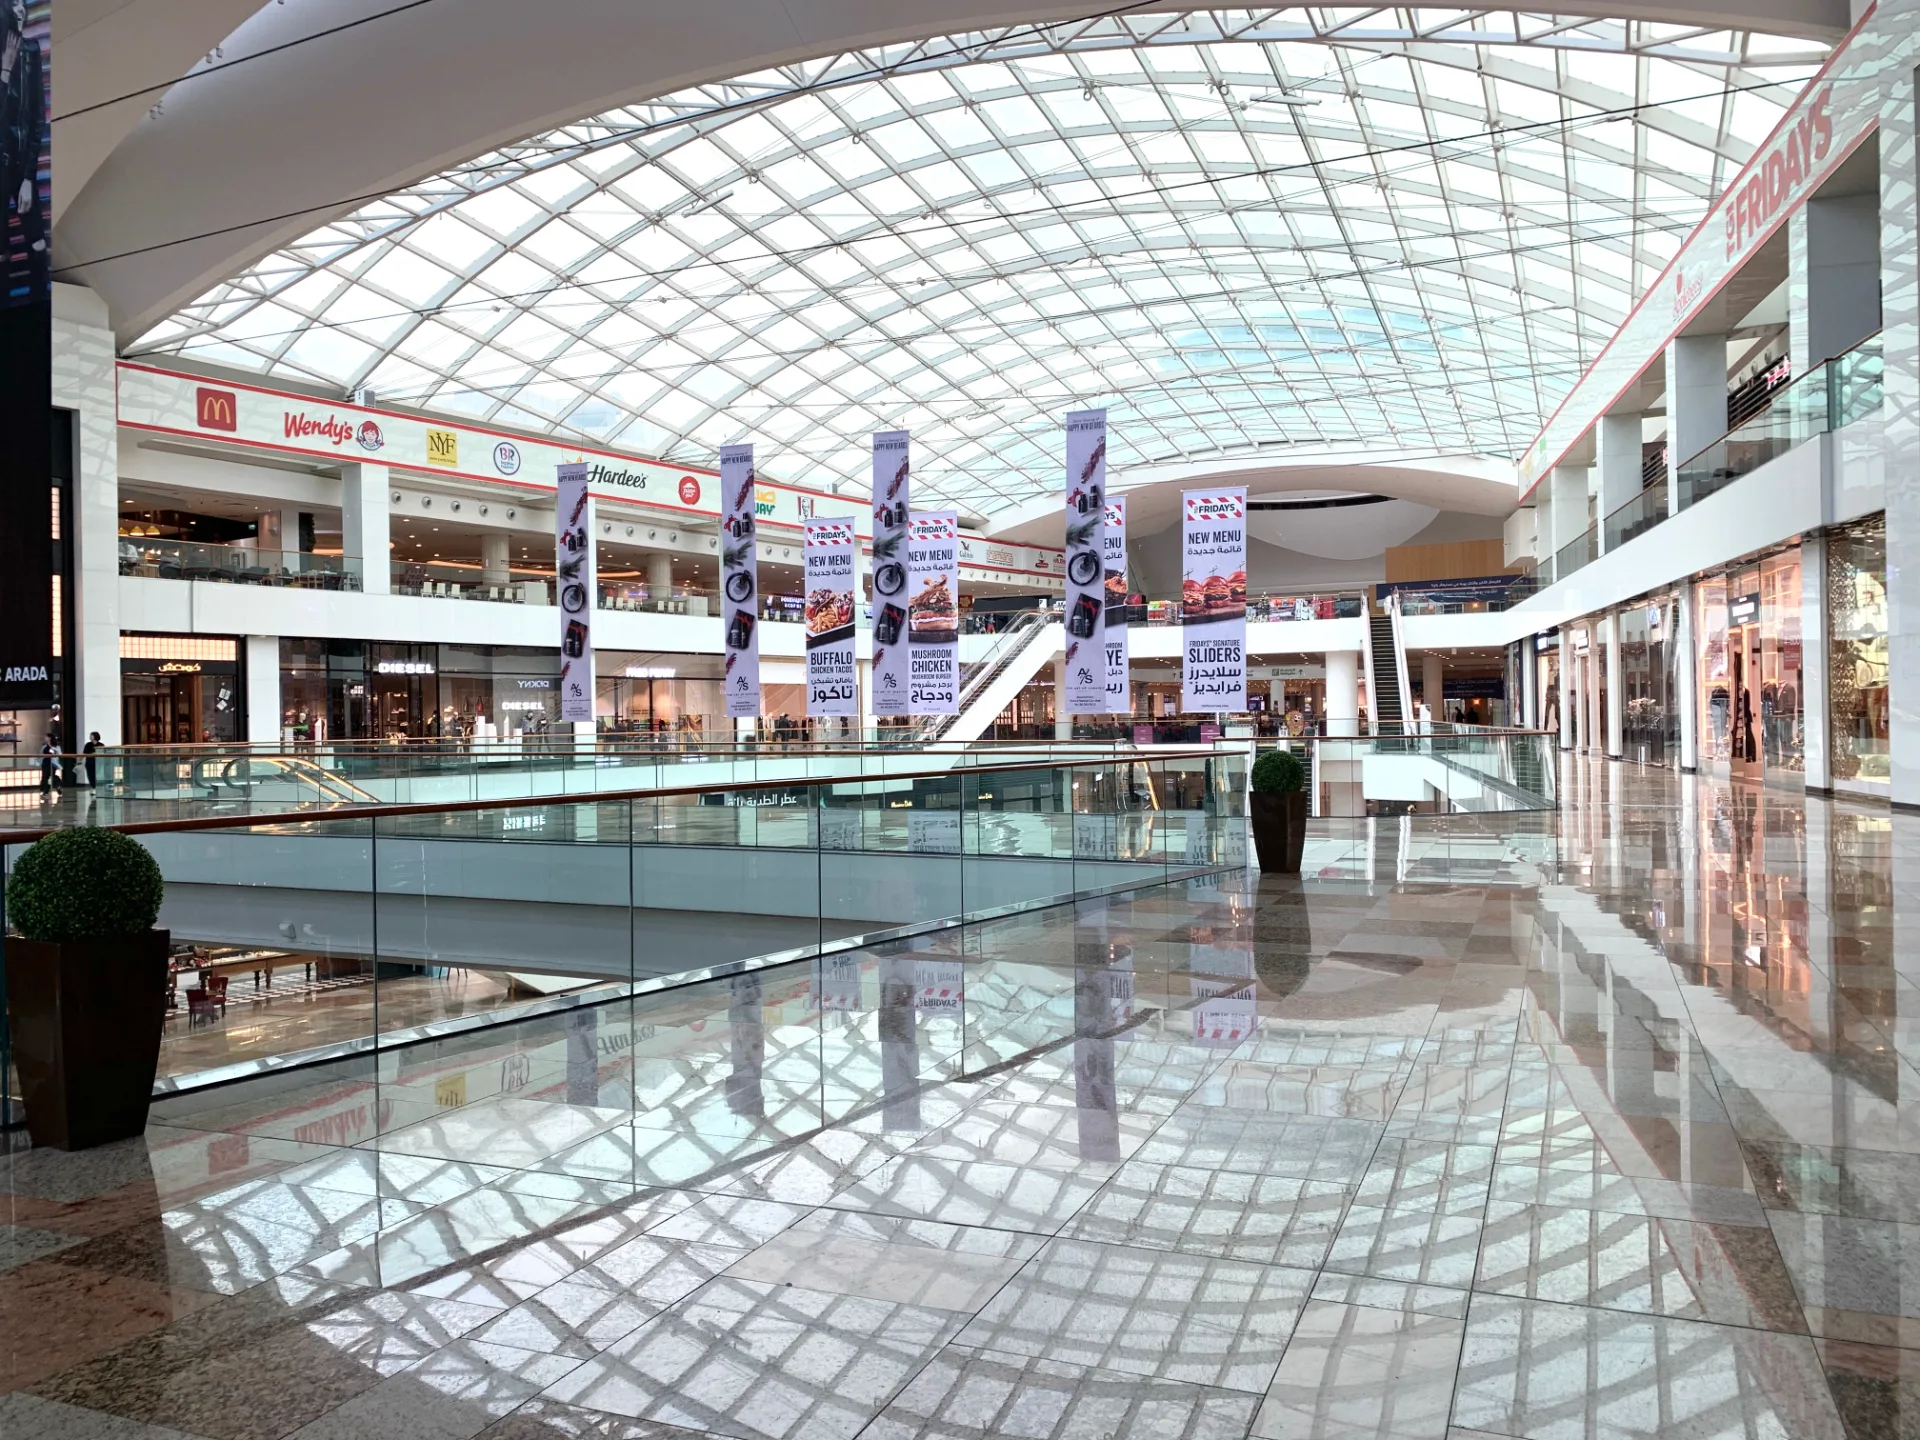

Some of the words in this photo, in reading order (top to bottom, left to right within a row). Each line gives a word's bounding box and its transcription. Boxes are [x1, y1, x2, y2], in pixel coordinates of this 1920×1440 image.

[1735, 87, 1833, 251] FRIDAYS
[284, 411, 354, 446] Wendy's
[429, 431, 456, 456] NYF
[587, 464, 646, 489] Hardee's
[1199, 503, 1235, 513] FRIDAYS
[817, 531, 846, 540] FRIDAYS
[917, 525, 948, 534] FRIDAYS
[1188, 532, 1210, 545] NEW
[1213, 529, 1241, 543] MENU
[908, 550, 926, 562] NEW
[929, 549, 953, 561] MENU
[1187, 547, 1215, 556] جديدة
[1217, 545, 1242, 554] قائمة
[808, 556, 826, 567] NEW
[828, 554, 851, 566] MENU
[933, 563, 954, 571] قائمة
[808, 569, 831, 577] جديدة
[908, 564, 931, 572] جديدة
[1212, 639, 1241, 648] SIGNATURE
[811, 651, 853, 666] BUFFALO
[911, 649, 953, 660] MUSHROOM
[1188, 646, 1241, 664] SLIDERS
[378, 662, 435, 674] DIESEL
[811, 666, 834, 674] CHICKEN
[835, 665, 853, 674] TACOS
[911, 660, 953, 673] CHICKEN
[1188, 666, 1242, 680] سلايدرز
[4, 666, 49, 682] ARADA
[811, 685, 853, 703] تاكوز
[1192, 680, 1242, 695] فرايديز
[911, 689, 953, 704] ودجاج
[501, 702, 544, 710] DIESEL
[780, 793, 797, 807] عطر
